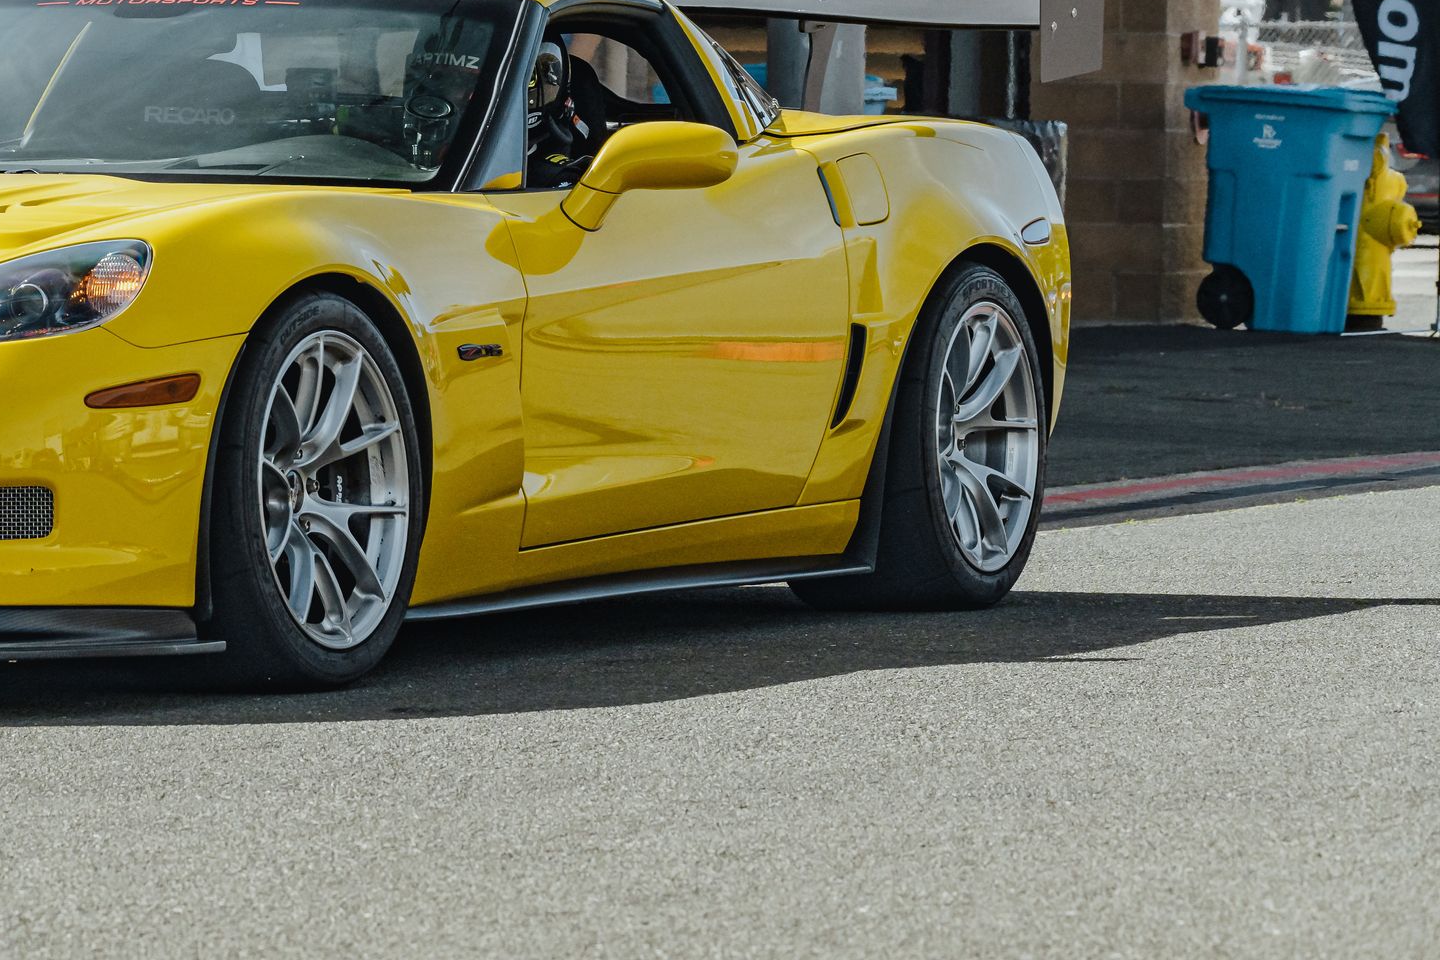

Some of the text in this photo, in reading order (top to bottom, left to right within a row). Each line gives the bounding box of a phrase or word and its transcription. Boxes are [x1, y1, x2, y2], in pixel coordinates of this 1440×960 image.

[415, 52, 481, 70] APTIMZ
[144, 106, 235, 125] RECARO
[280, 305, 320, 345] OUTSIDE
